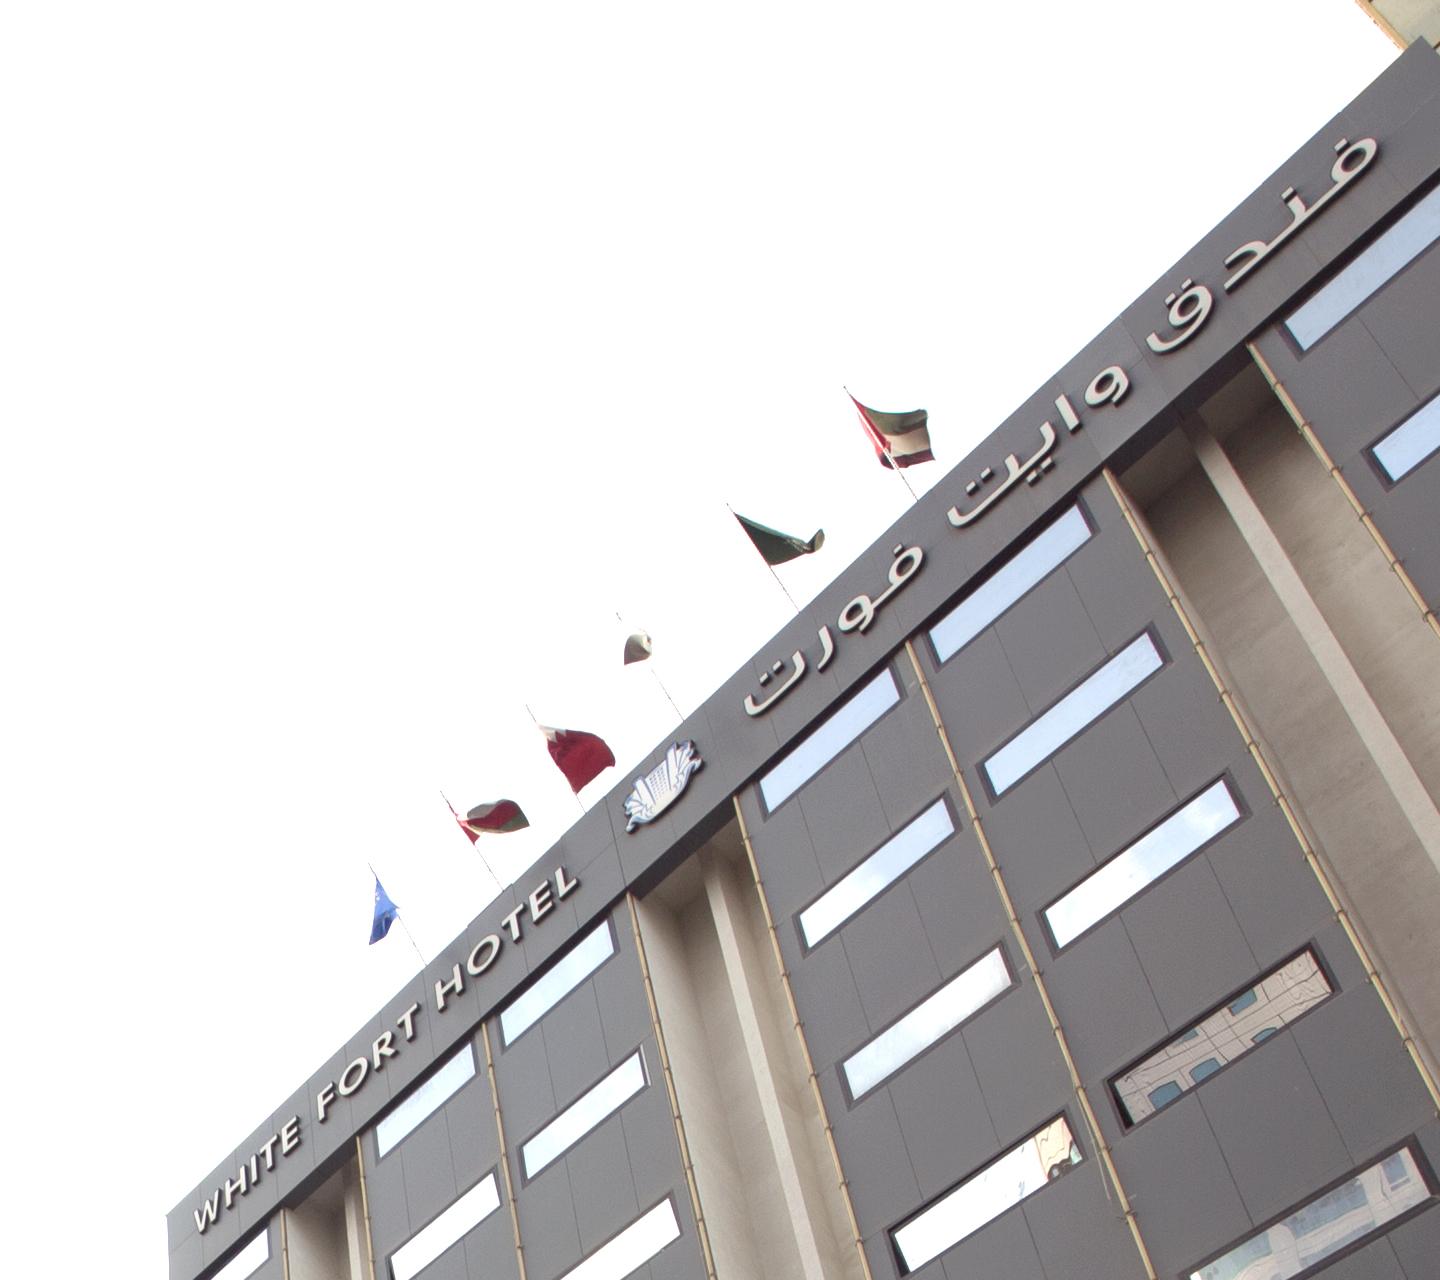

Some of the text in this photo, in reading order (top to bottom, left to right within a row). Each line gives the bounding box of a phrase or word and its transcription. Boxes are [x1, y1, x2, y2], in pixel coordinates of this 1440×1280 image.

[744, 137, 1379, 718] فندق وايت فورت
[193, 866, 580, 1234] WHITE FORT HOTEL
